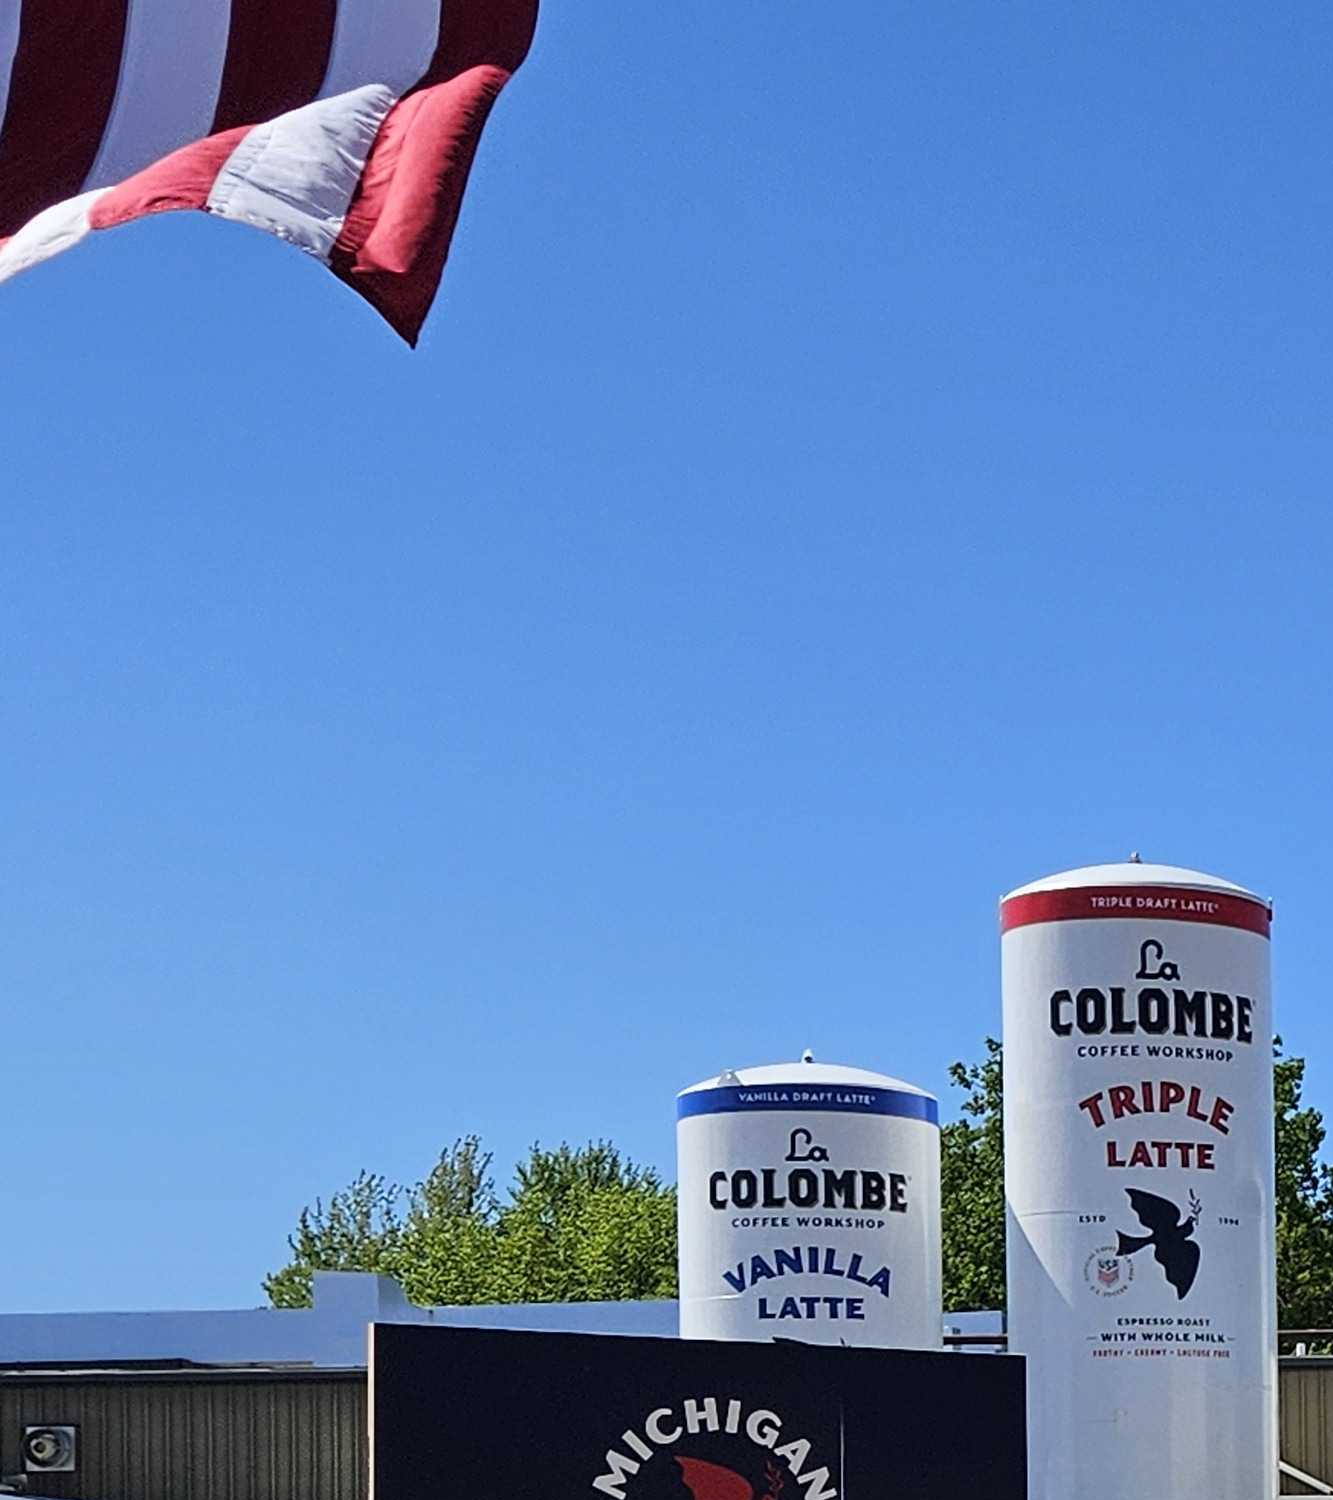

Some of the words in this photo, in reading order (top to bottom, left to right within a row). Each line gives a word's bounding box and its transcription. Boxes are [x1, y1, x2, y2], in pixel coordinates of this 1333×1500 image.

[1090, 896, 1132, 908] TRIPLE
[1136, 897, 1176, 909] DRAFT
[1135, 939, 1180, 981] La
[1050, 987, 1253, 1044] COLOMBE
[1077, 1045, 1140, 1057] COFFEE
[1146, 1046, 1234, 1062] WORKSHOP
[739, 1092, 789, 1103] VANILLA
[793, 1092, 832, 1102] DRAFT
[1078, 1081, 1235, 1136] TRIPLE
[785, 1127, 830, 1162] La
[1107, 1141, 1216, 1170] LATTE
[709, 1168, 907, 1213] COLOMBE
[732, 1217, 790, 1228] COFFEE
[796, 1217, 885, 1229] WORKSHOP
[722, 1246, 891, 1298] VANILLA
[758, 1297, 865, 1319] LATTE
[1117, 1318, 1174, 1326] ESPRESSO
[1177, 1318, 1210, 1327] ROAST
[1100, 1332, 1137, 1342] WITH
[1142, 1332, 1191, 1342] WHOLE
[1195, 1333, 1225, 1343] MILK
